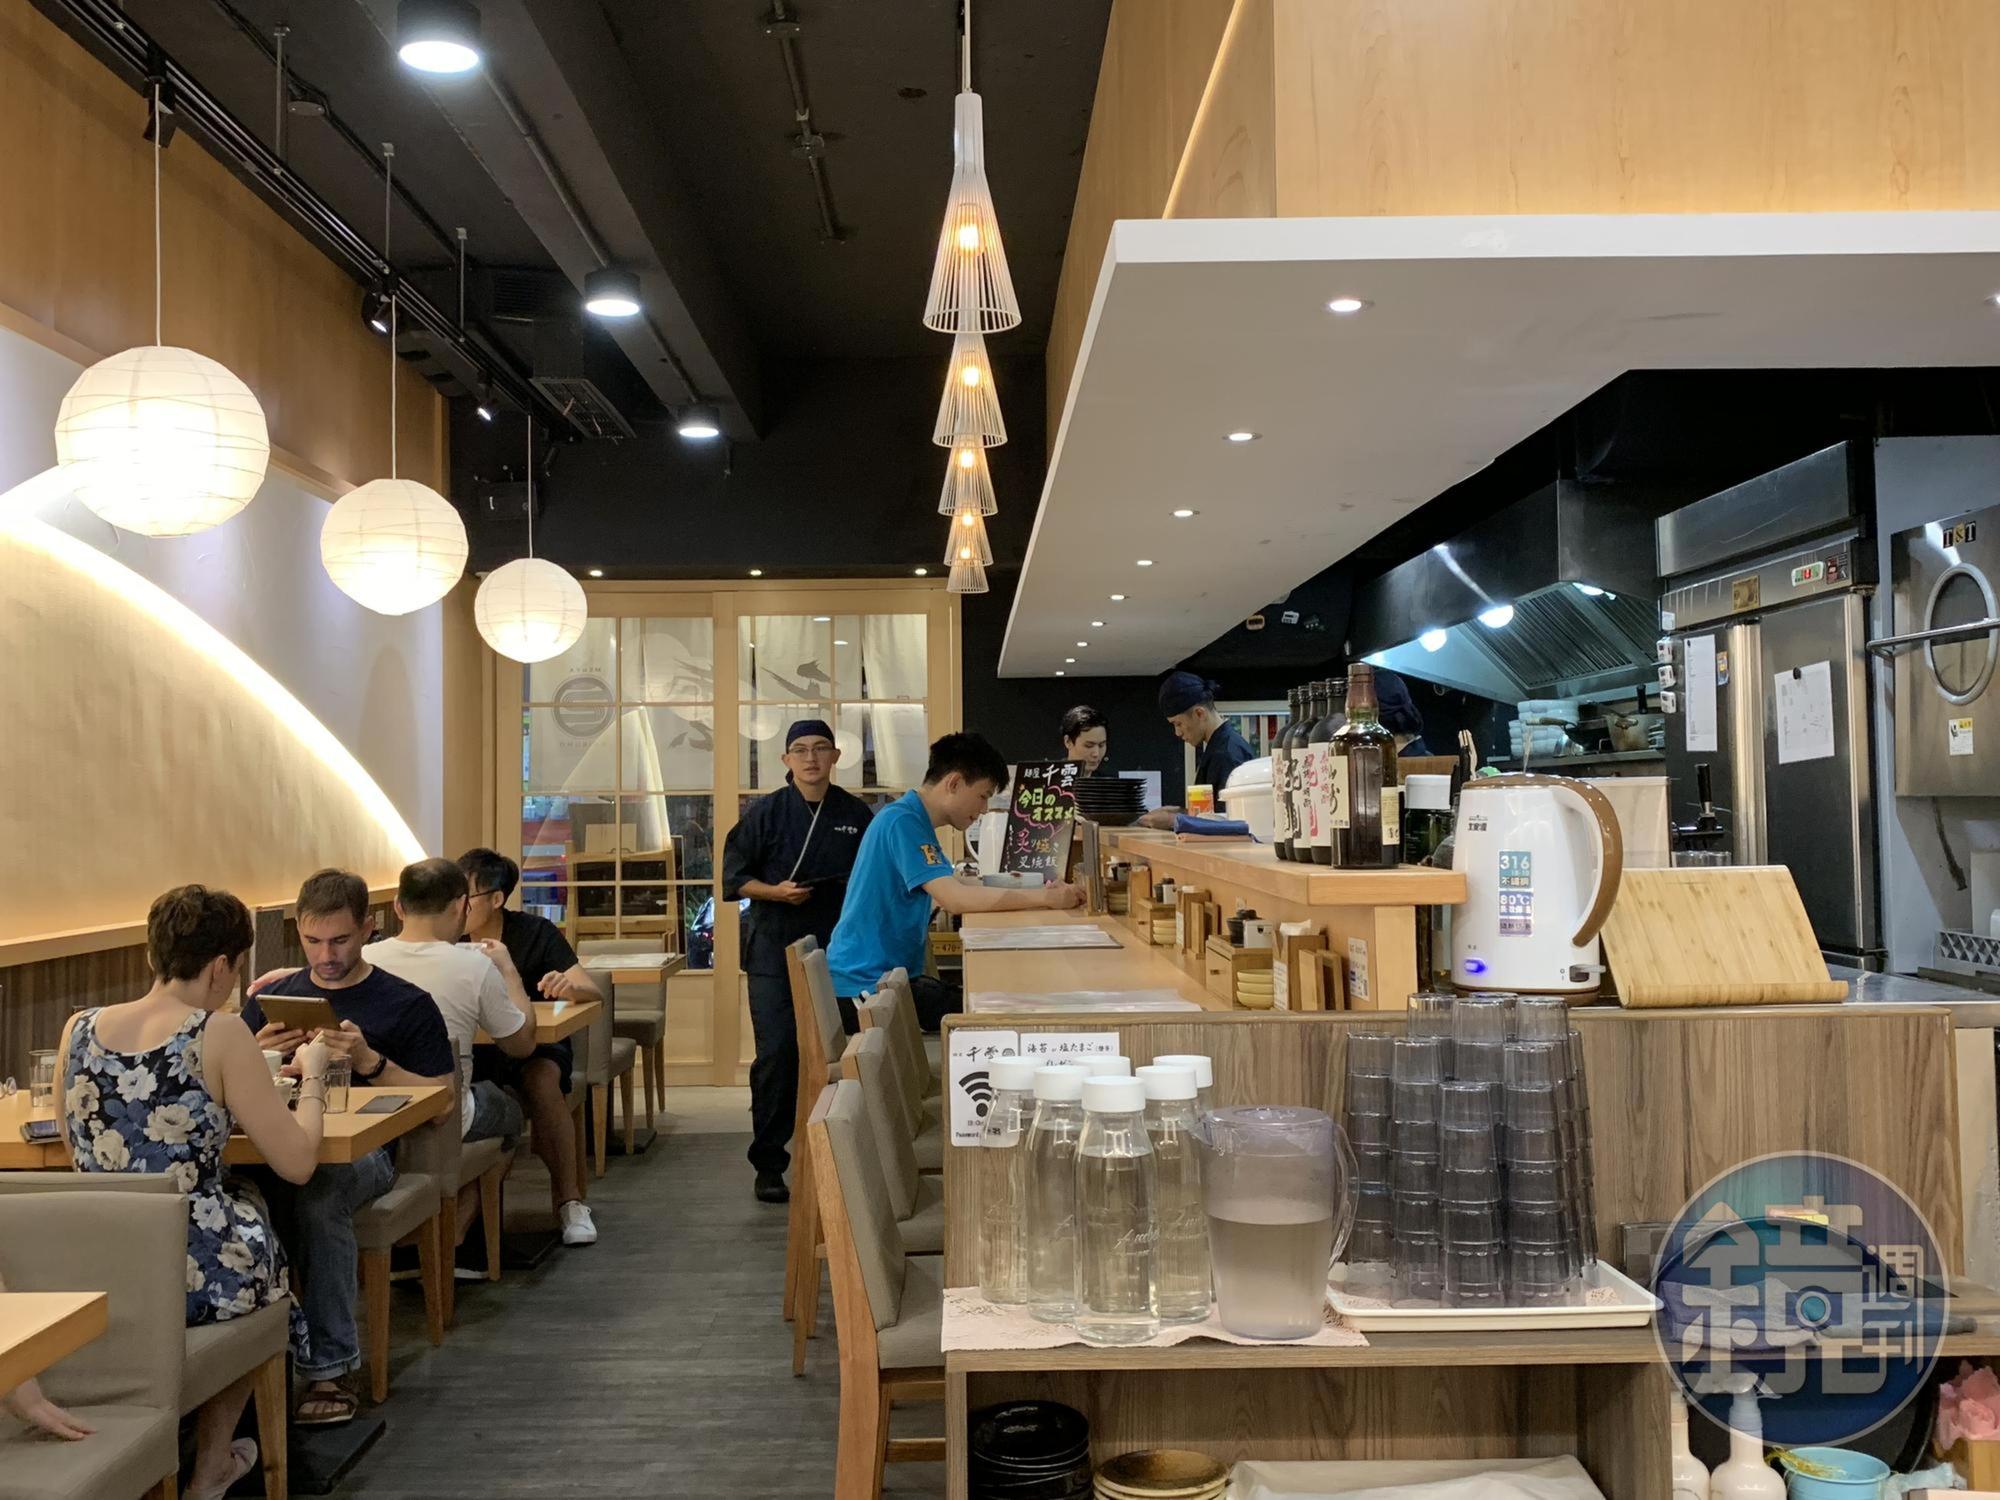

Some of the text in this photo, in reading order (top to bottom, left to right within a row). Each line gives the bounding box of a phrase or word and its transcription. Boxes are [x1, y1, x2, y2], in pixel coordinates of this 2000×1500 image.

[1943, 521, 1976, 548] T&T
[1018, 788, 1056, 807] 今日の
[1032, 806, 1074, 822] オススメ
[1500, 855, 1530, 869] 316
